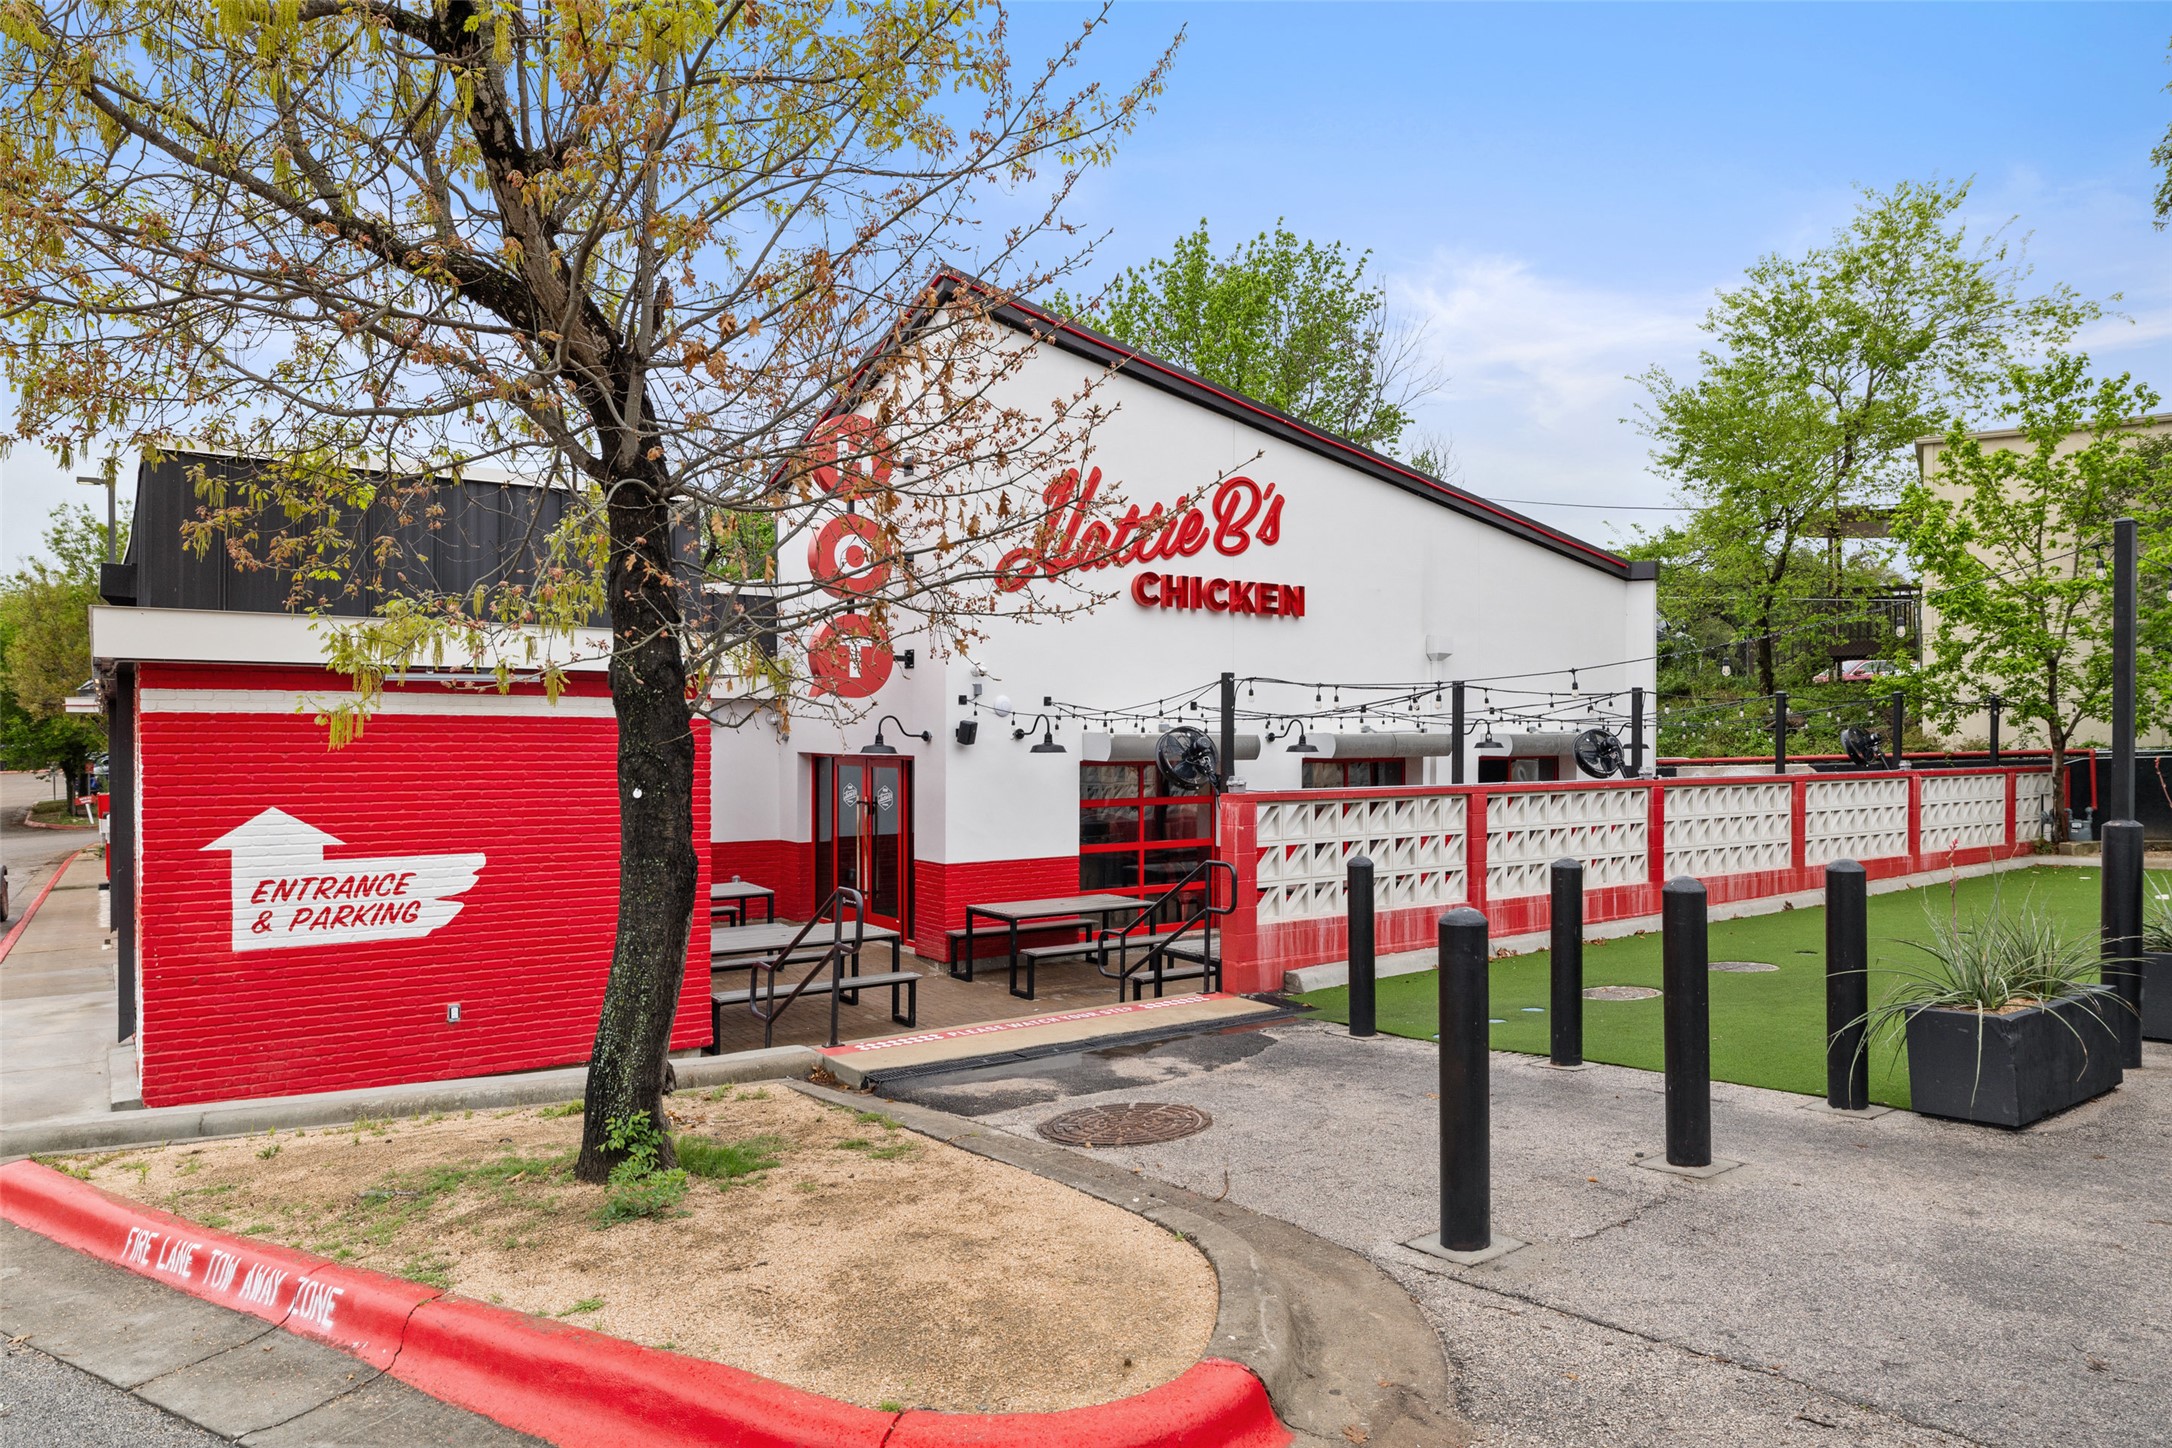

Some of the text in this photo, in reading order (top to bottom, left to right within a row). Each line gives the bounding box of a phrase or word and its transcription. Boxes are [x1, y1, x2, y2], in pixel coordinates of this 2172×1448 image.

[994, 466, 1285, 592] Hattie B's
[834, 433, 876, 678] HOT
[1131, 571, 1305, 617] CHICKEN
[250, 872, 417, 905] ENTRANCE
[250, 900, 422, 935] & PARKING
[947, 1006, 1132, 1038] PLEASE WATCH YOUR STEP
[120, 1226, 345, 1328] FIRE LANE TOW AWAY ZONE
